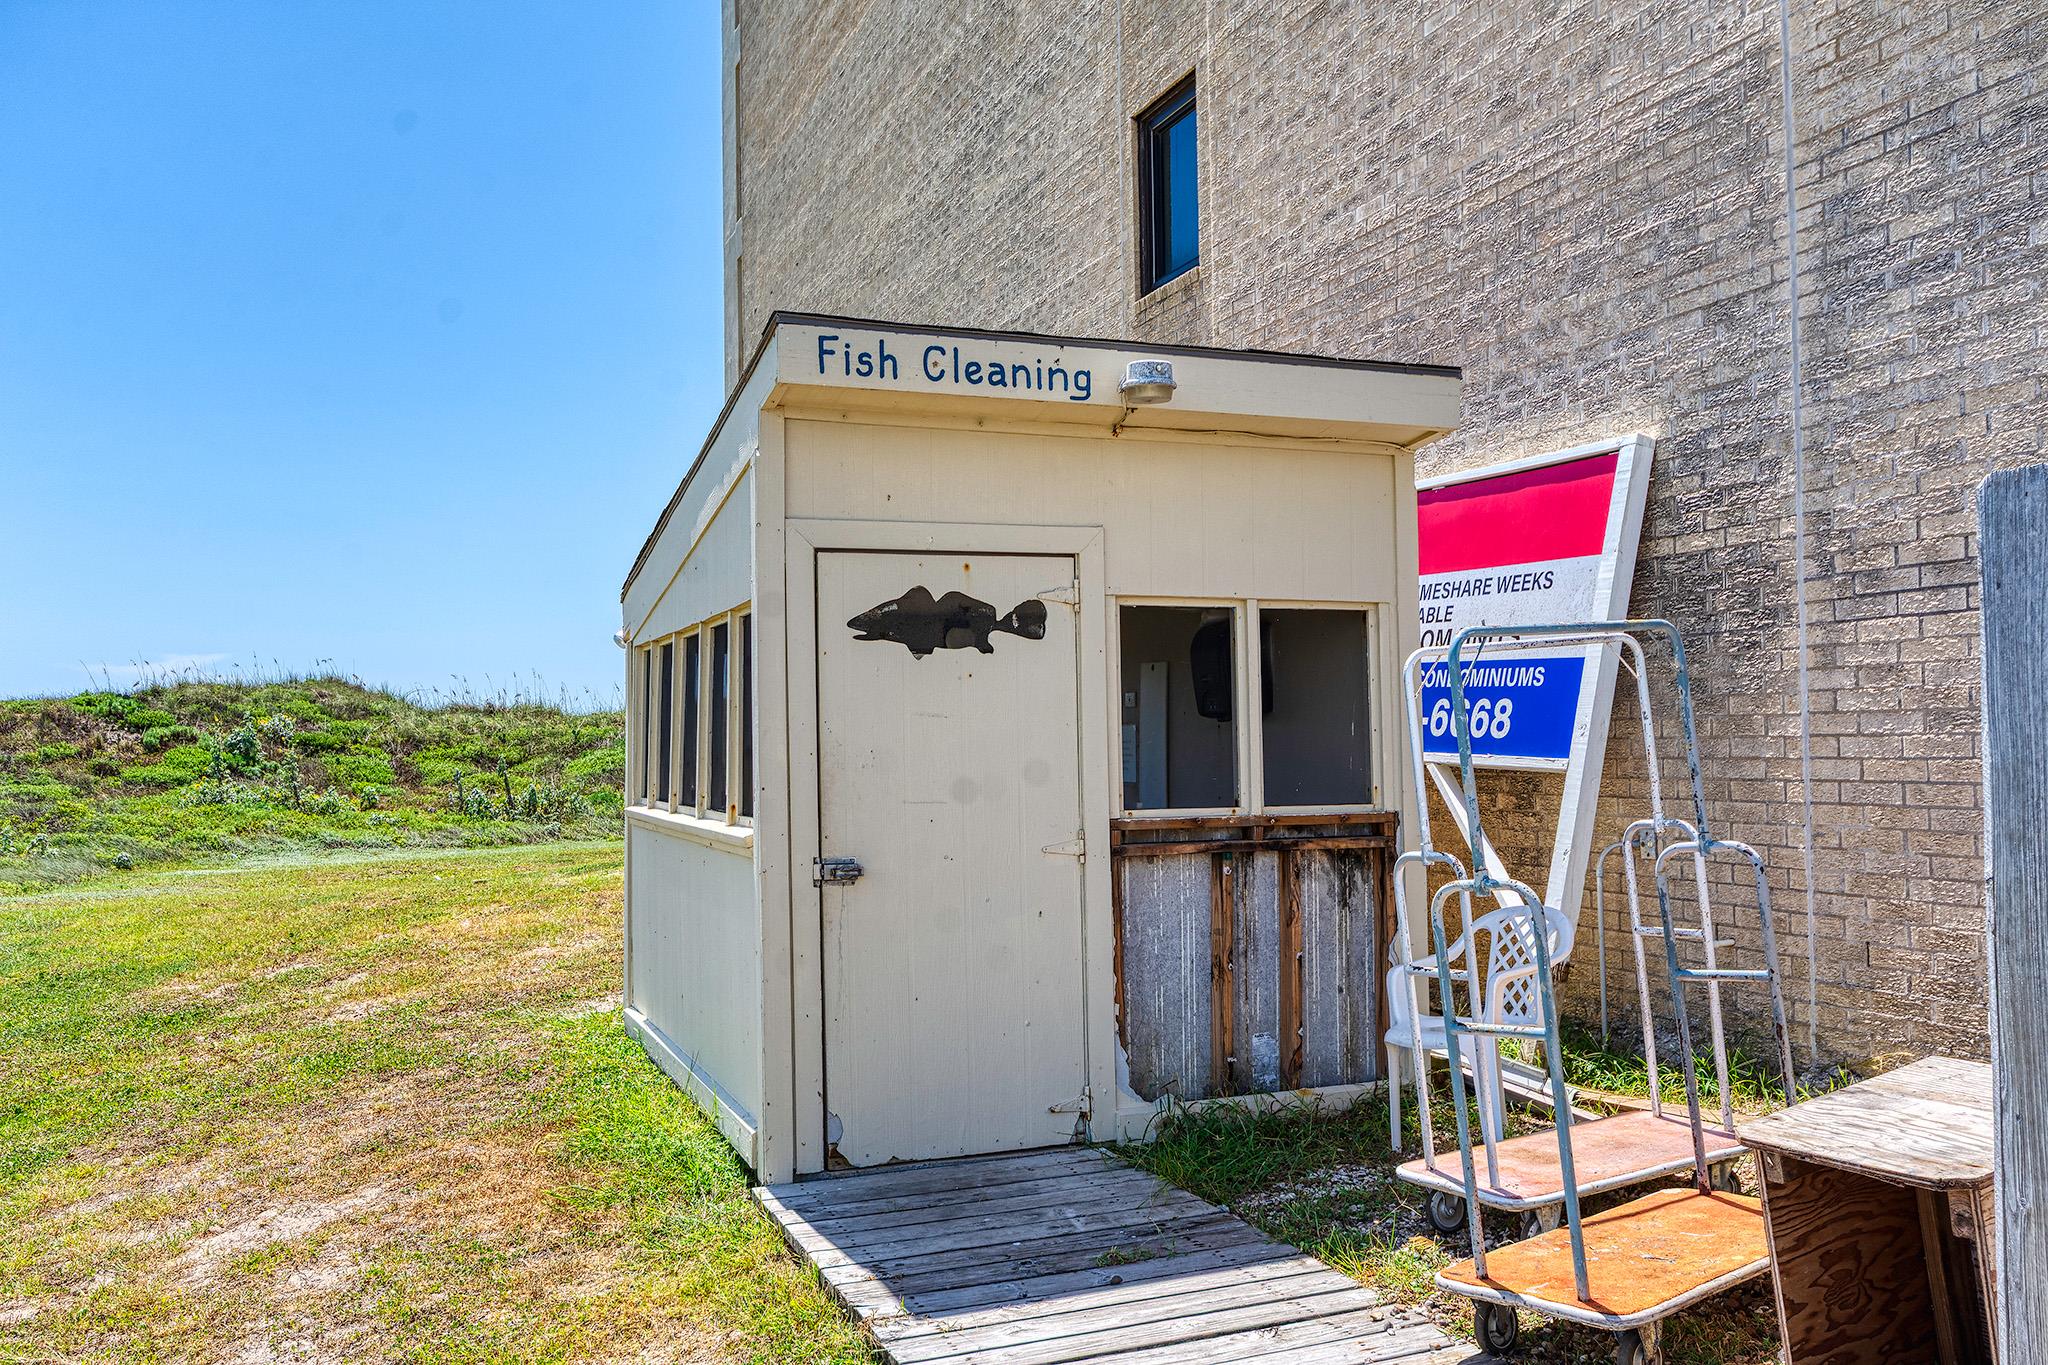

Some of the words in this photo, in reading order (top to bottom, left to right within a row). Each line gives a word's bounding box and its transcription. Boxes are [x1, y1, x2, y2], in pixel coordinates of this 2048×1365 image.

[817, 335, 898, 380] Fish
[922, 344, 1092, 401] Cleaning
[1418, 577, 1494, 601] MESHARE
[1497, 570, 1555, 594] WEEKS
[1419, 605, 1454, 624] ABLE
[1421, 666, 1546, 688] ONOMINIUMS
